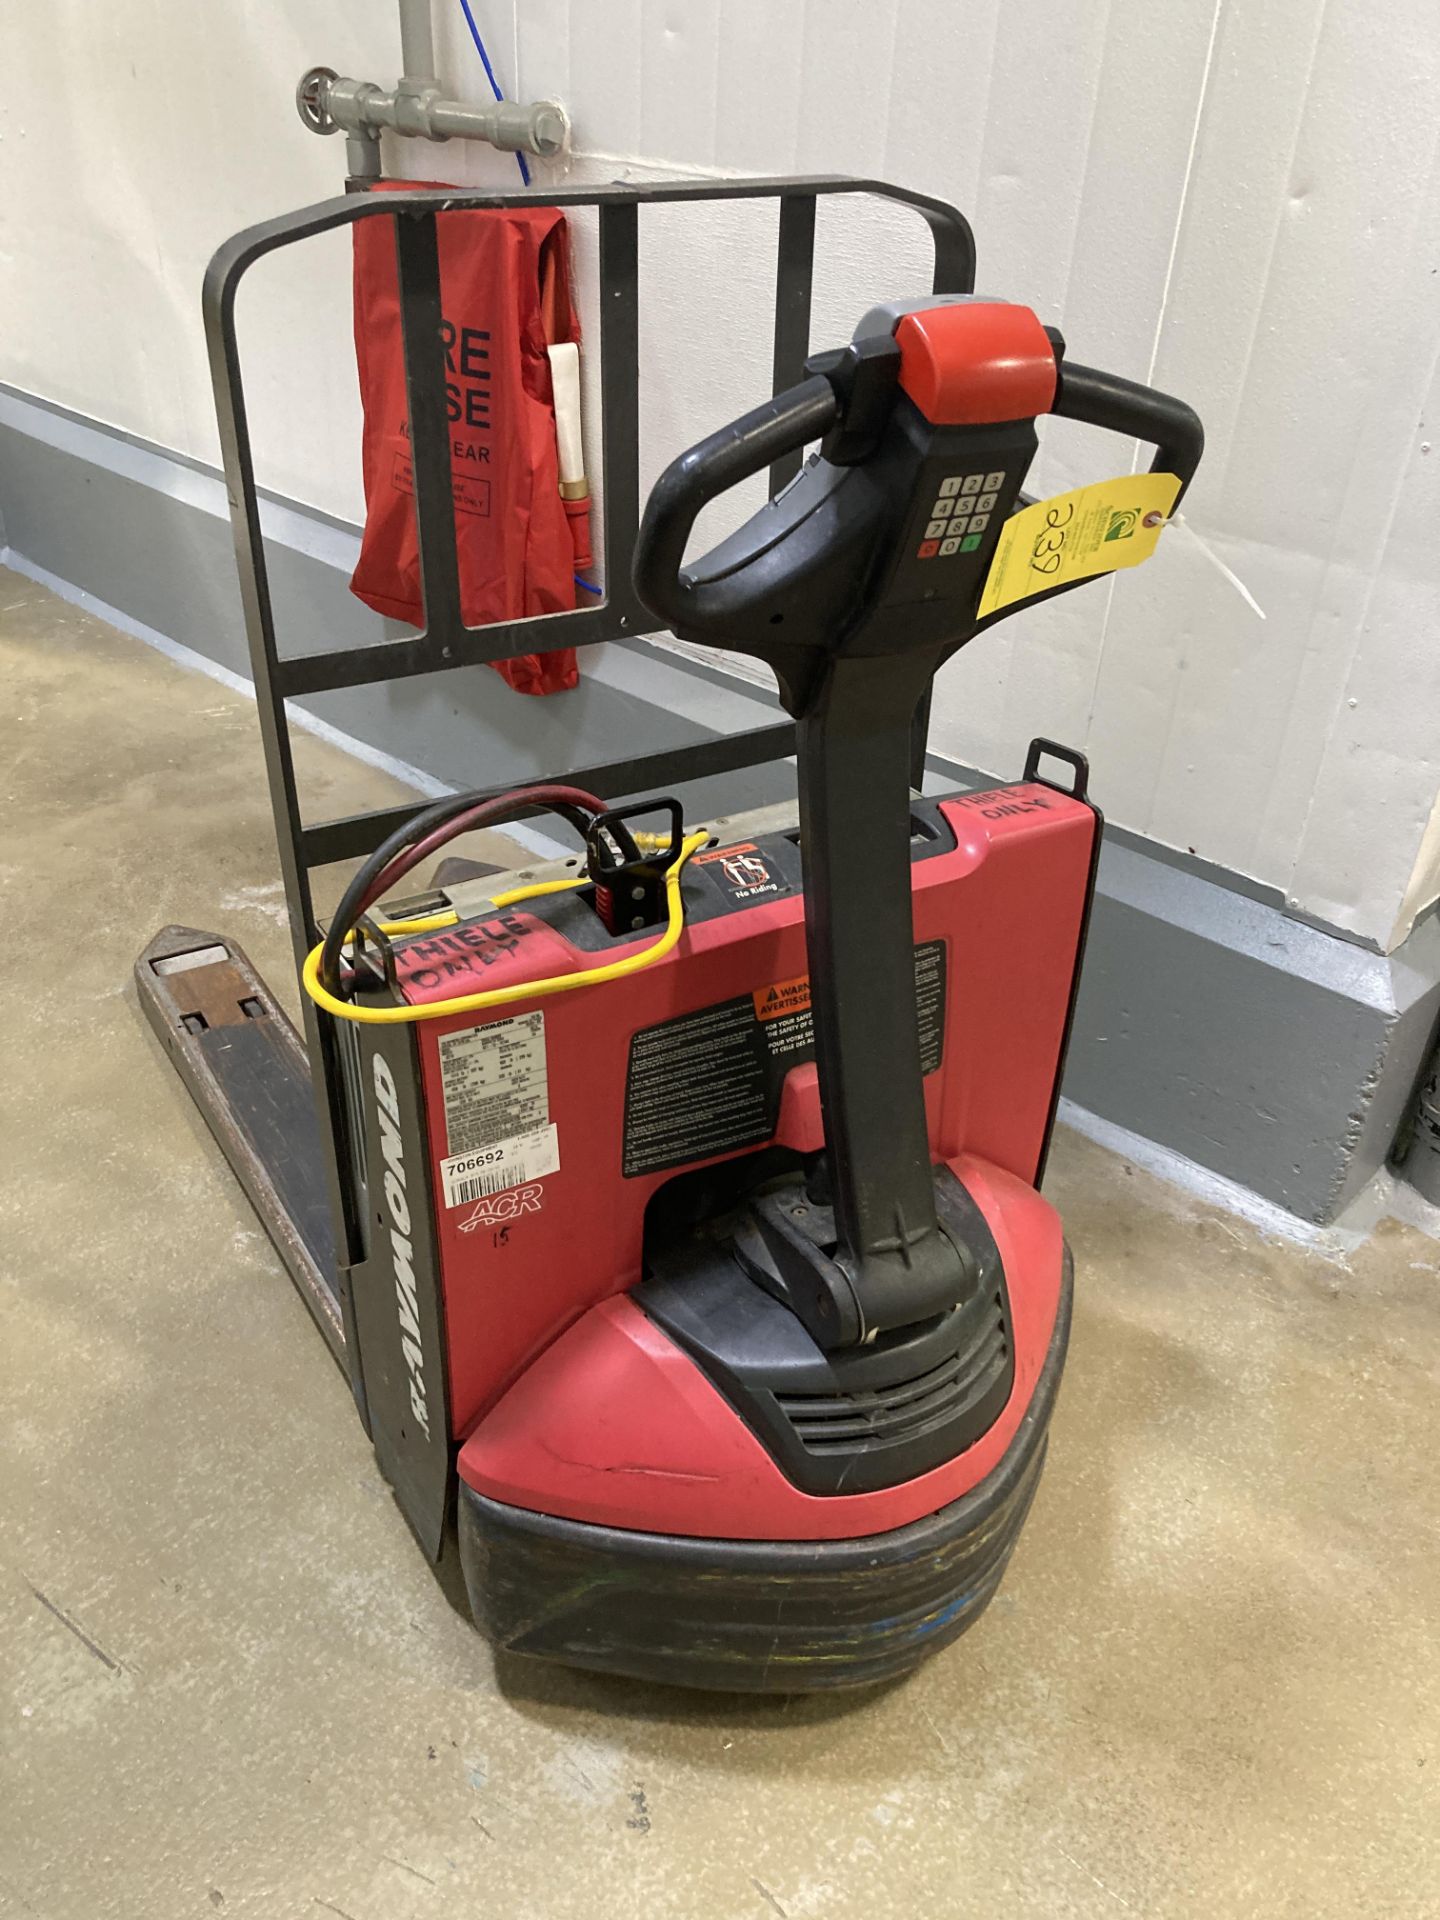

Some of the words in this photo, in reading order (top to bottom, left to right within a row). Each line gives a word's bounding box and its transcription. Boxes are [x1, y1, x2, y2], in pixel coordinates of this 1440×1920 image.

[440, 319, 491, 381] RE
[446, 383, 491, 429] SE
[454, 441, 490, 463] EAR
[968, 479, 977, 491] 2
[989, 475, 999, 489] 3
[939, 503, 948, 515] 4
[960, 500, 969, 512] 5
[982, 497, 991, 509] 6
[932, 524, 941, 535] 7
[953, 521, 962, 533] 8
[975, 517, 983, 530] 9
[945, 541, 955, 552] 0
[1032, 503, 1074, 574] 239
[981, 798, 1052, 820] ONLY
[735, 890, 750, 899] No
[750, 883, 778, 895] Riding
[394, 916, 532, 967] THIELE
[410, 938, 519, 988] ONLY
[760, 993, 810, 1014] AVERTISSE
[474, 1018, 514, 1033] RAYMOND
[778, 1018, 795, 1027] YOUR
[796, 1012, 813, 1023] SAFET
[779, 1024, 799, 1035] SAFETY
[768, 1039, 785, 1049] POUR
[785, 1034, 804, 1043] VOTRE
[780, 1044, 795, 1053] CELLE
[447, 1149, 504, 1177] 706692
[457, 1183, 543, 1233] ACR
[372, 1052, 430, 1443] RAYMOND
